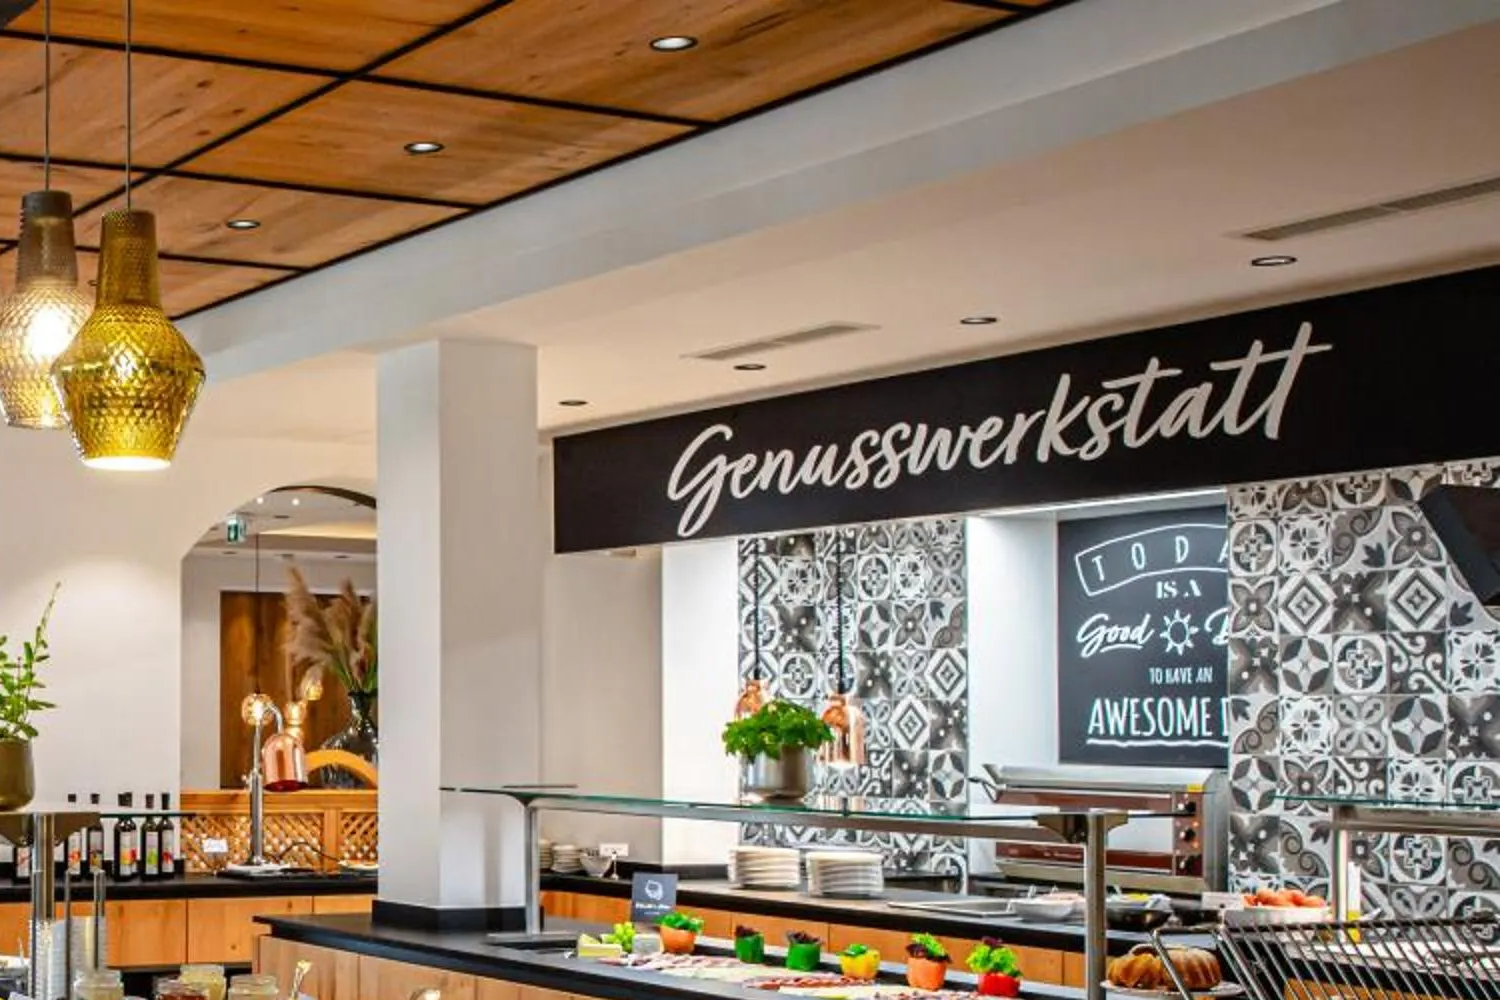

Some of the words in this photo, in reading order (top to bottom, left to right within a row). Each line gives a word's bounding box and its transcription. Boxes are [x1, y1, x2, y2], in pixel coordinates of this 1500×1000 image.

[667, 321, 1333, 538] Genusswerkstatt
[1156, 580, 1179, 599] IS
[1183, 579, 1202, 597] A
[1076, 613, 1155, 658] Good
[1149, 667, 1163, 684] TO
[1165, 667, 1193, 684] HAVE
[1195, 666, 1213, 683] AN
[1087, 696, 1214, 737] AWESOME
